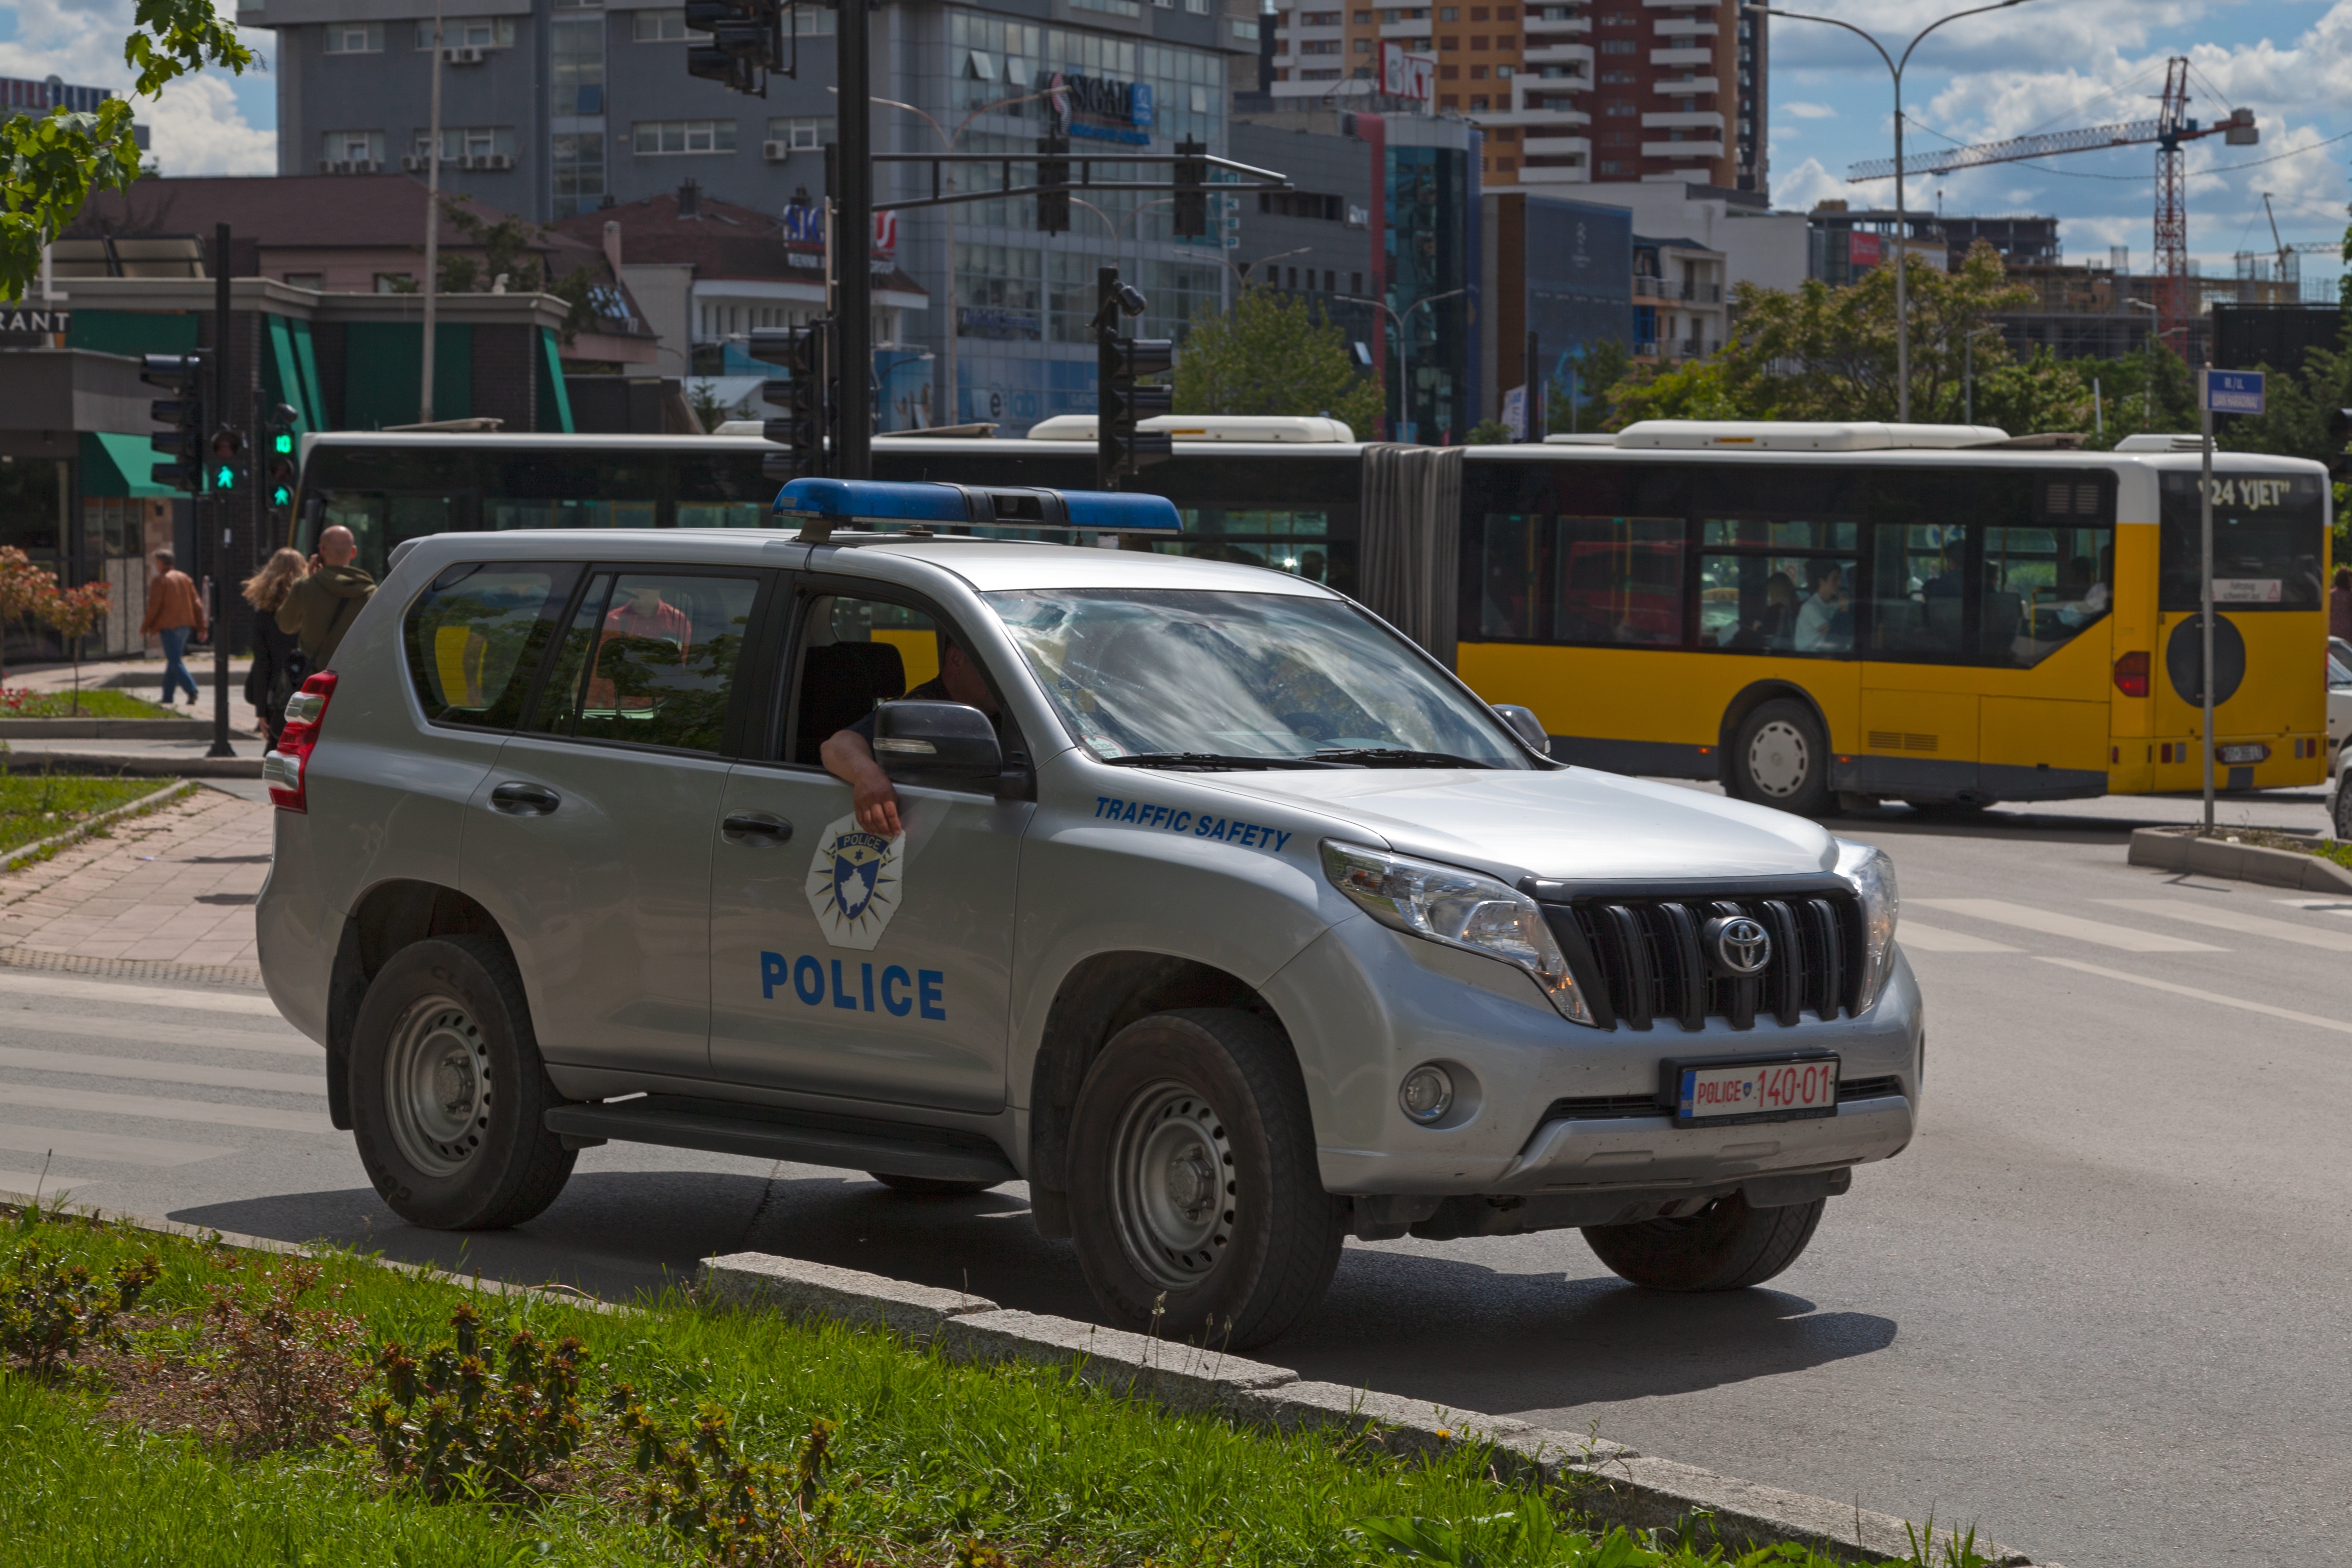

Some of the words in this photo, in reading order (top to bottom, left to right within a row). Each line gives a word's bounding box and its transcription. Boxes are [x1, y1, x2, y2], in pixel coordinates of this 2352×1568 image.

[1384, 42, 1433, 98] BKT
[842, 833, 882, 850] POLICE
[1094, 797, 1192, 832] TRAFFIC
[1194, 815, 1292, 852] SAFETY
[760, 951, 947, 1021] POLICE
[1682, 1099, 1693, 1110] RKS
[1697, 1080, 1742, 1114] POLICE
